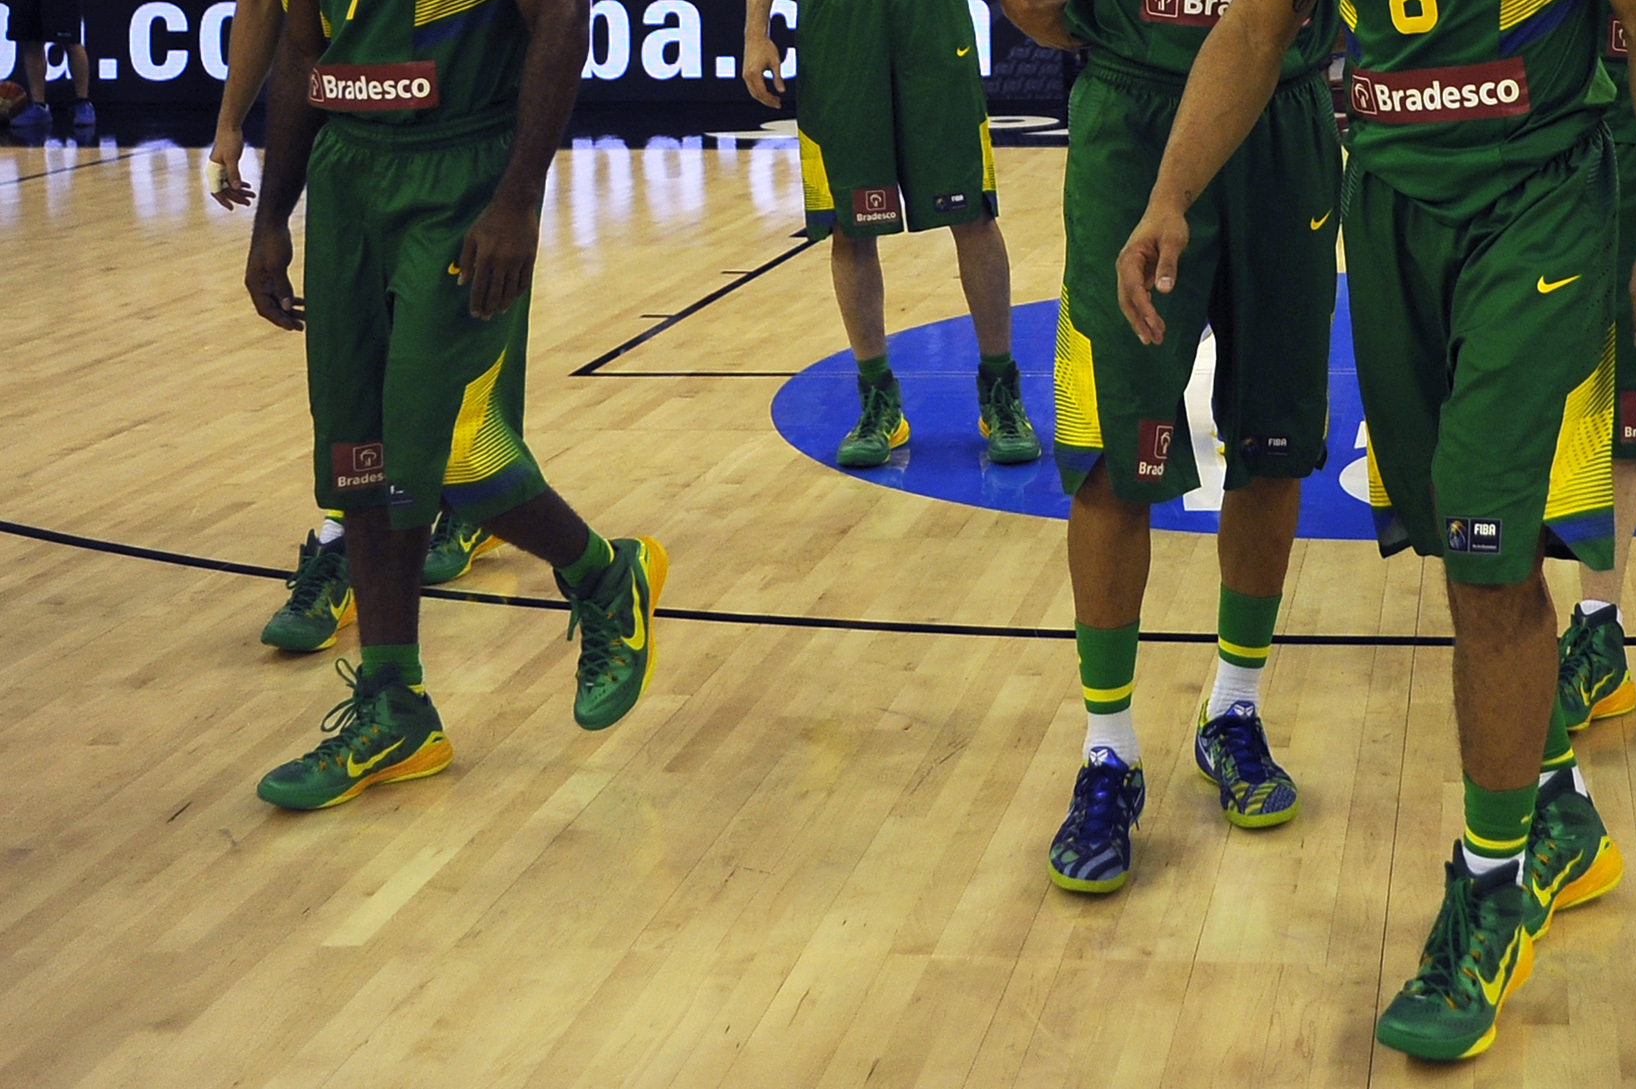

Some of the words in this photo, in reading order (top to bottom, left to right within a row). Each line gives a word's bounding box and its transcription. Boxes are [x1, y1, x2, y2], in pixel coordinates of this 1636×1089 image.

[321, 75, 432, 101] Bradesco
[1373, 77, 1521, 113] Bradesco
[856, 211, 897, 223] Bradesco
[1268, 437, 1288, 448] FIBA
[1474, 523, 1497, 536] FIBA
